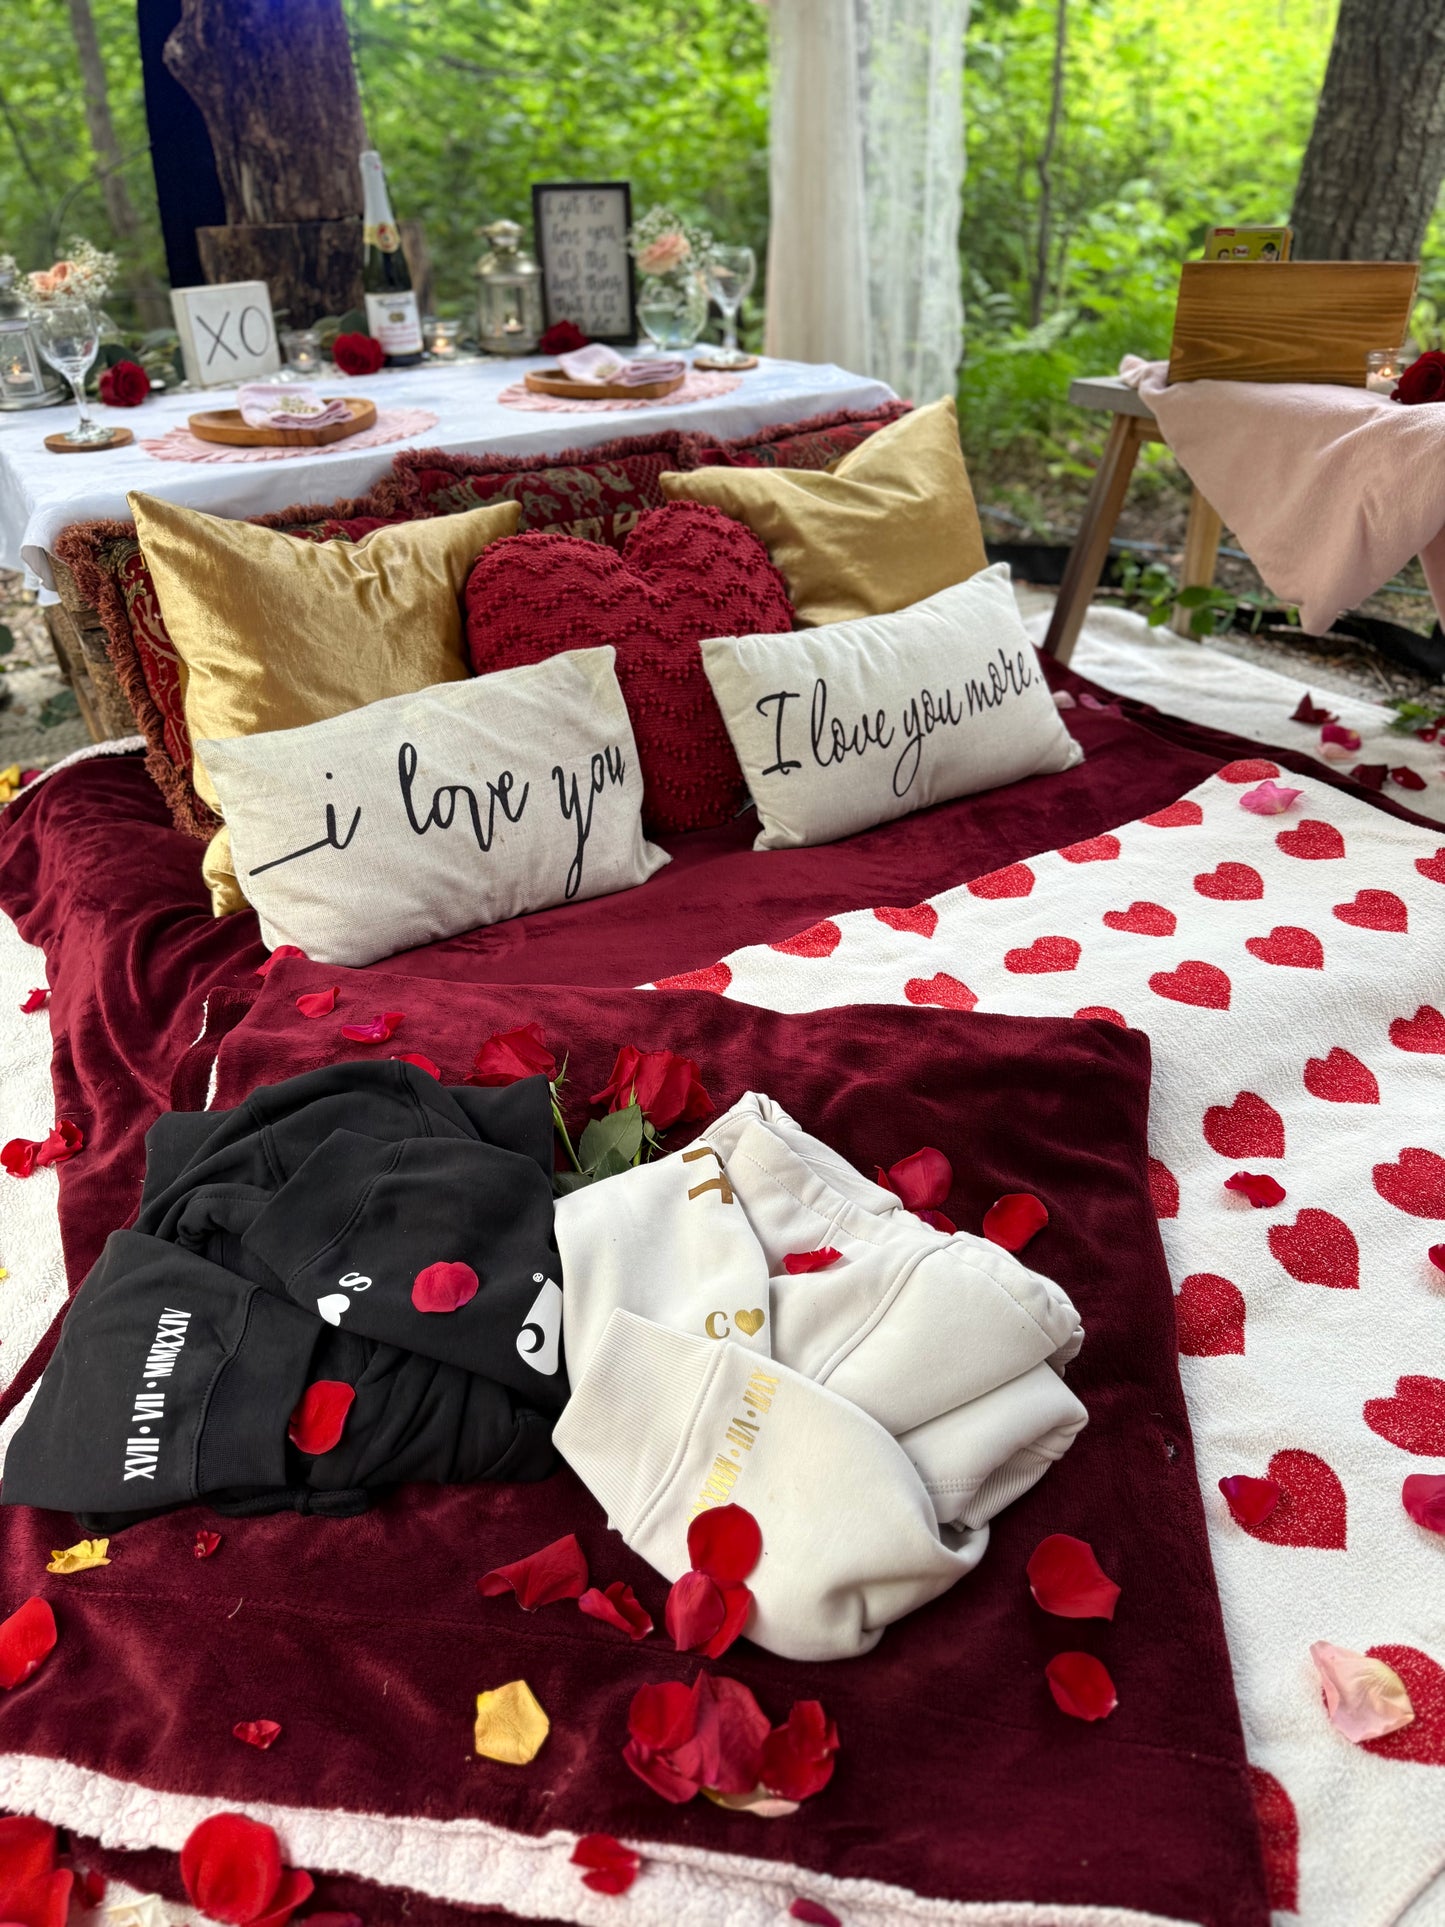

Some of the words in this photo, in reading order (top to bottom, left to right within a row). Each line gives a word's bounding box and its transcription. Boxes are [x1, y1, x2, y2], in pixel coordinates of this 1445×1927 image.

[195, 305, 271, 366] XO
[756, 690, 802, 776] I
[810, 678, 895, 767] love
[893, 688, 963, 797] you
[248, 772, 361, 877] i
[398, 742, 529, 852] love
[552, 744, 626, 899] you
